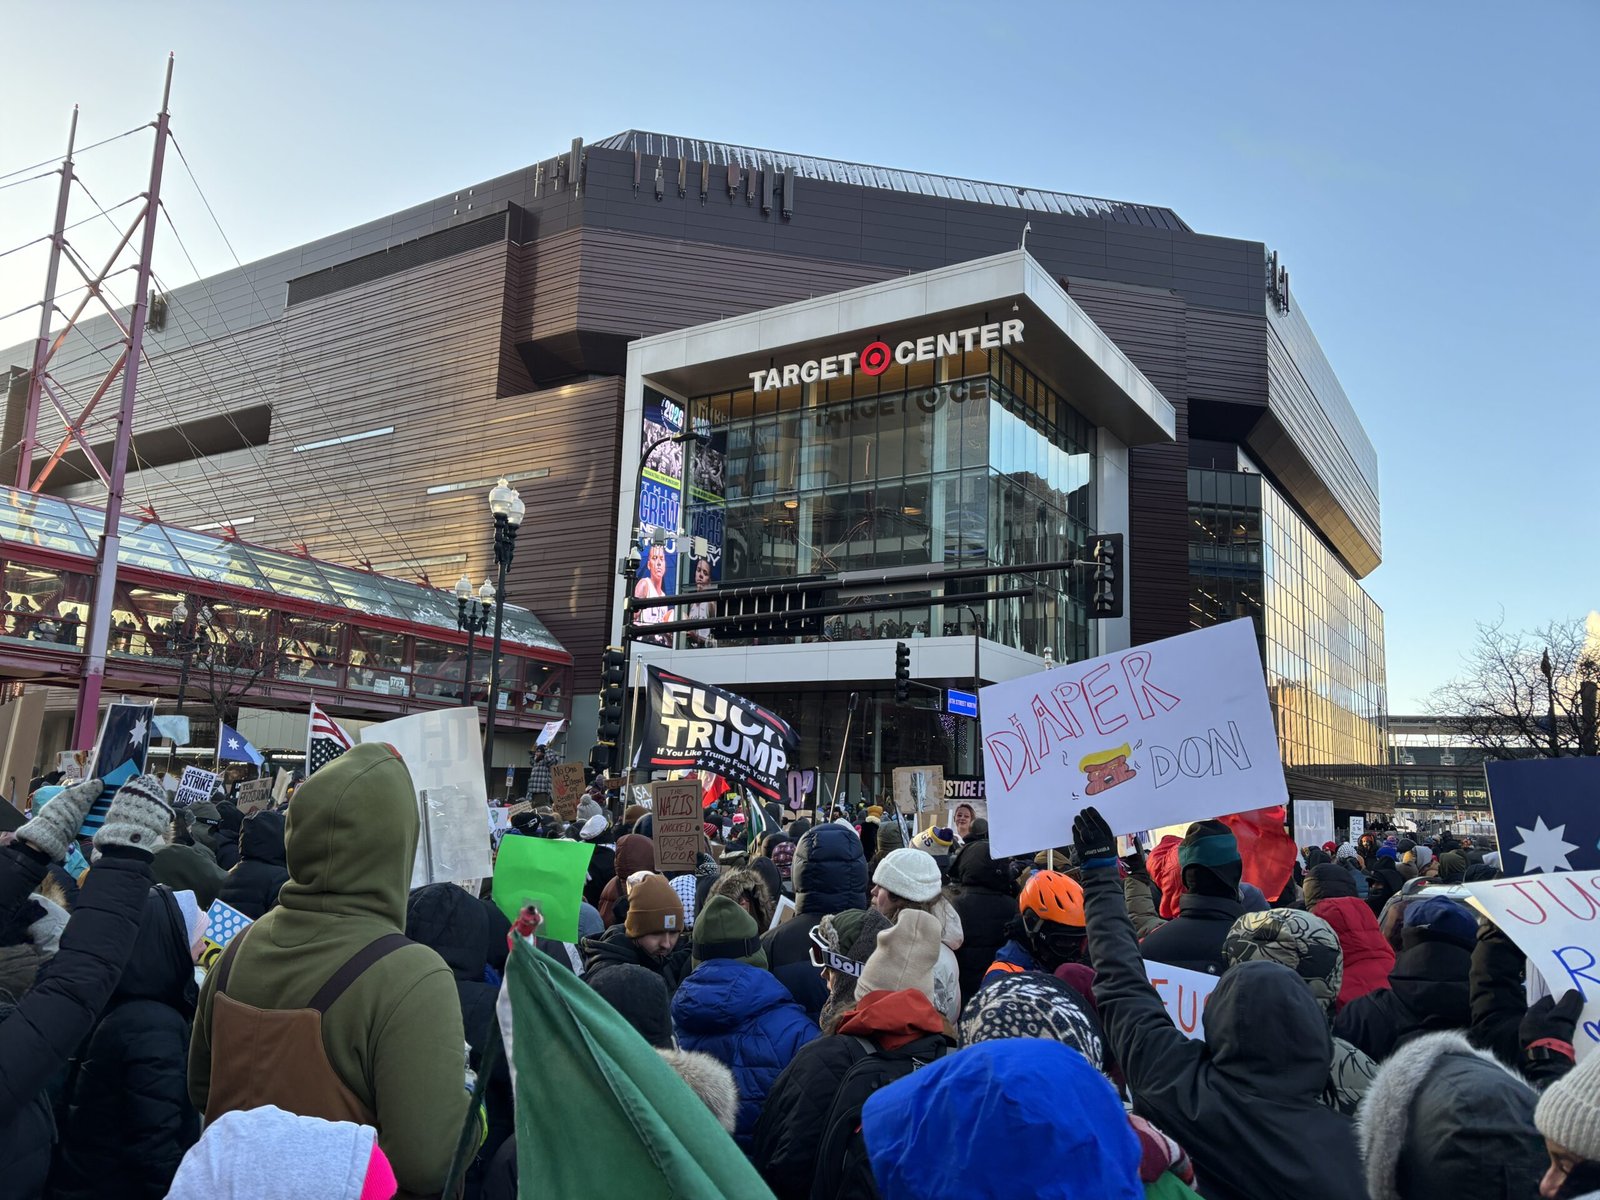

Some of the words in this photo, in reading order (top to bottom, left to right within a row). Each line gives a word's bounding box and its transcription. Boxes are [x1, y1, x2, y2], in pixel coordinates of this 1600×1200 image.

[749, 352, 858, 393] TARGET
[895, 319, 1025, 365] CENTER
[663, 400, 684, 428] 2026
[640, 490, 680, 532] CREW
[660, 716, 787, 777] TRUMP
[1150, 720, 1252, 790] DON
[657, 747, 664, 755] If
[665, 748, 684, 757] You
[684, 749, 702, 757] Like
[703, 750, 731, 764] Trump
[732, 760, 751, 774] Fuck
[752, 768, 768, 783] You
[182, 774, 213, 793] STRIKE
[660, 794, 694, 816] NAZIS
[660, 822, 692, 834] KNOCKED
[662, 837, 694, 847] DOOR
[662, 850, 695, 863] DOOR
[1494, 876, 1600, 926] JU
